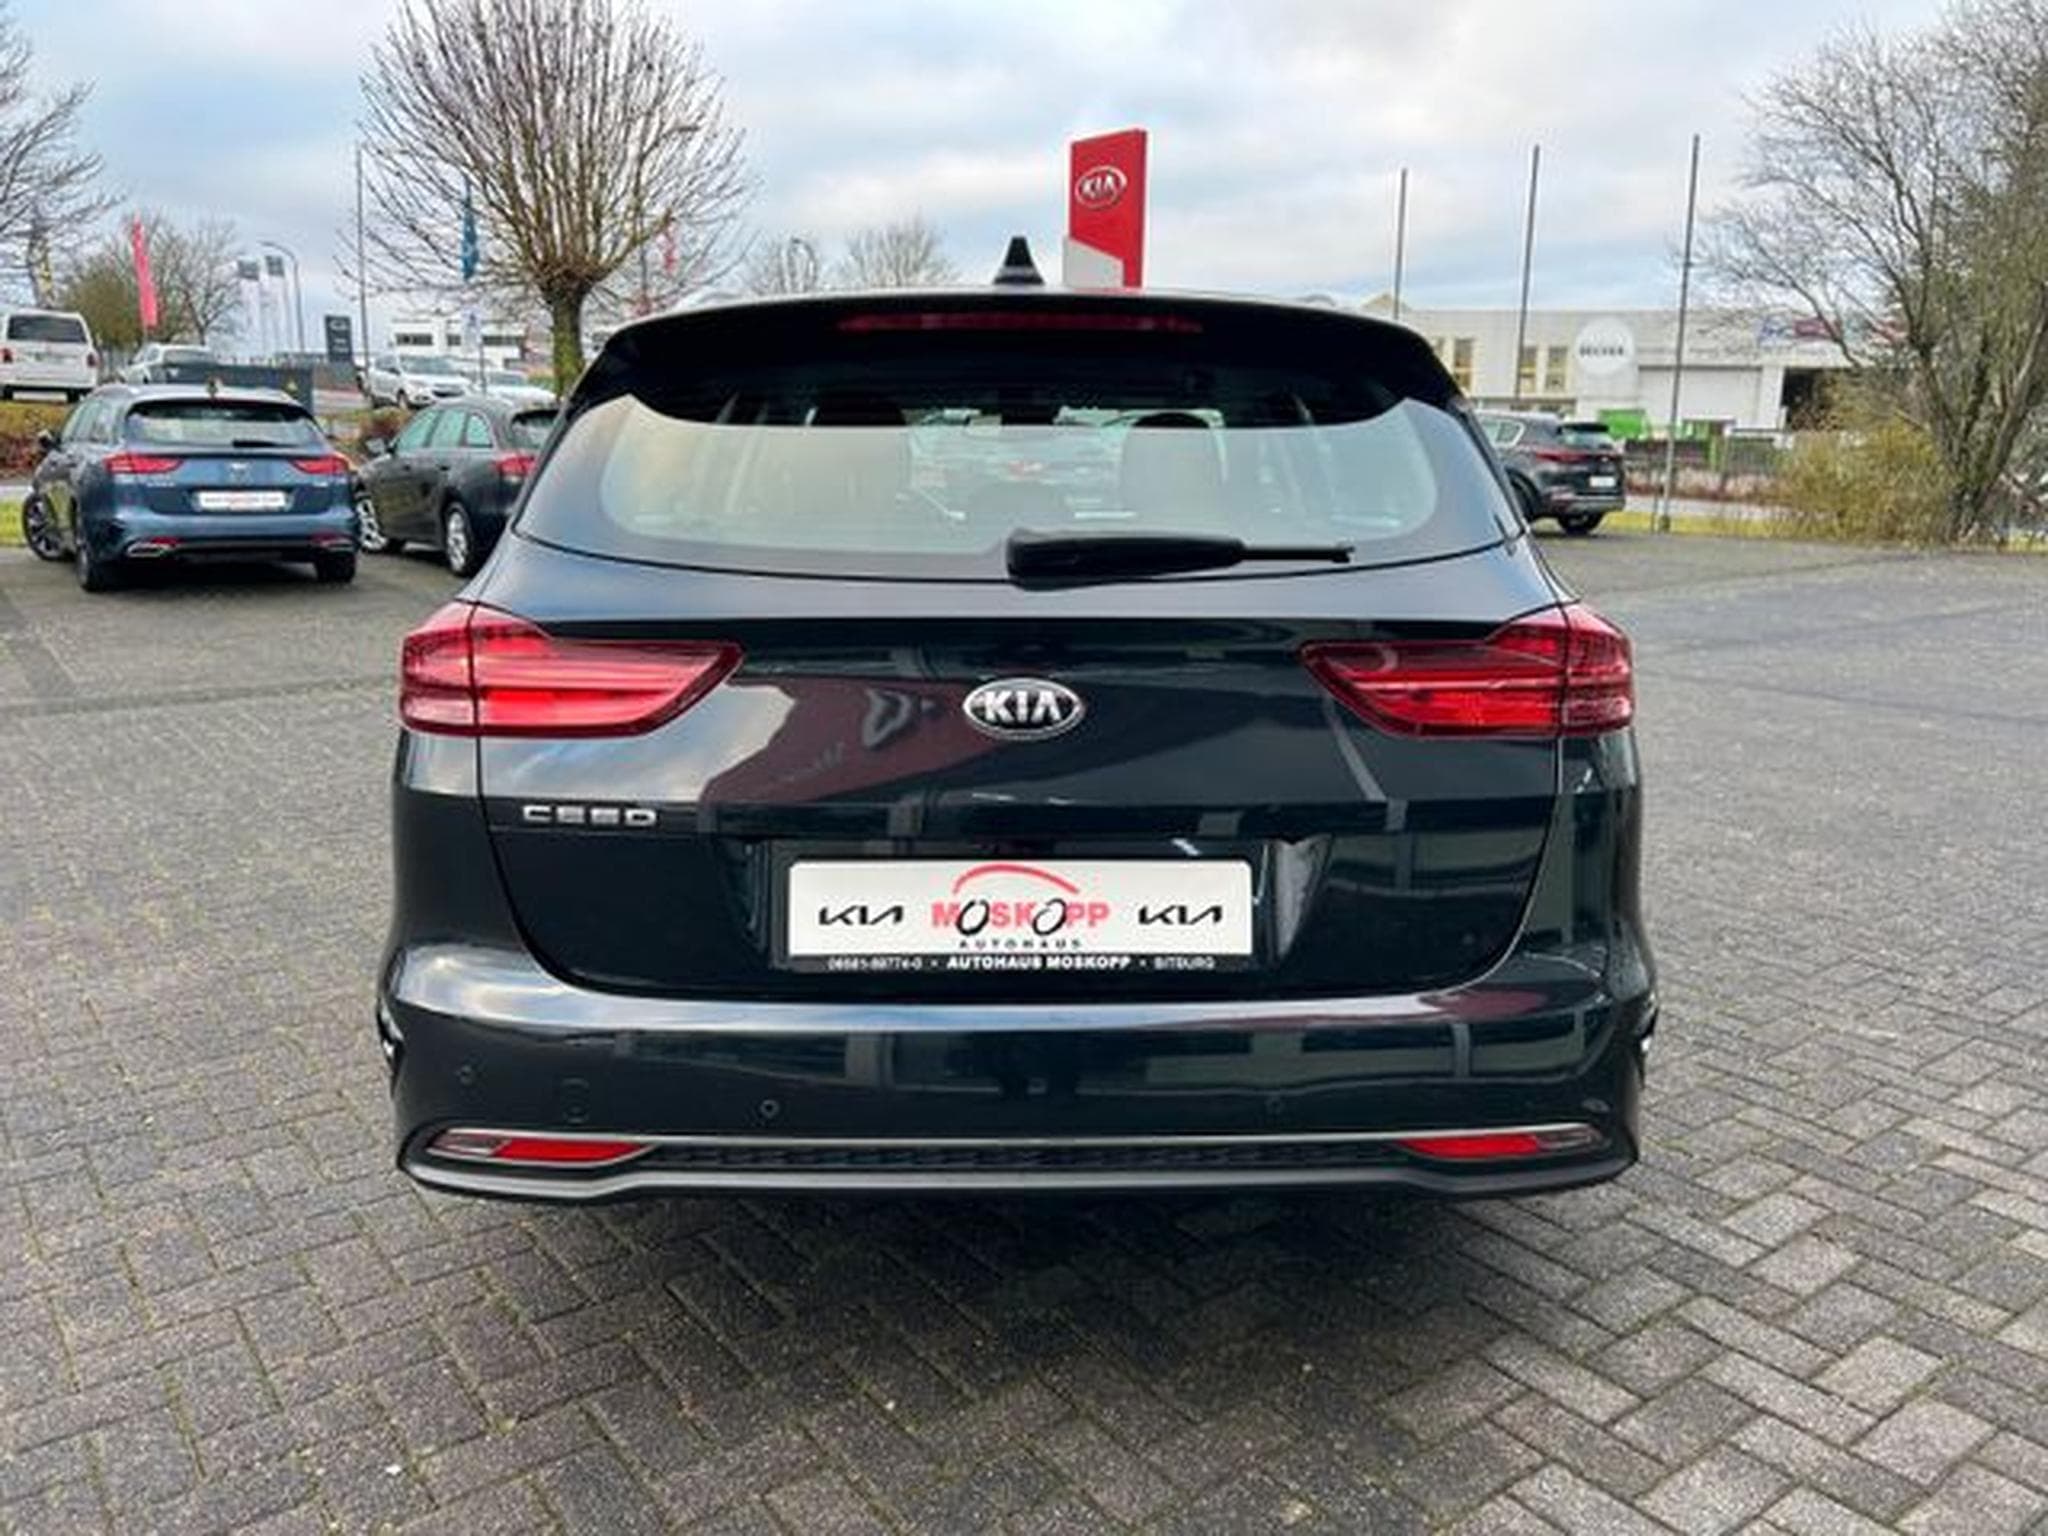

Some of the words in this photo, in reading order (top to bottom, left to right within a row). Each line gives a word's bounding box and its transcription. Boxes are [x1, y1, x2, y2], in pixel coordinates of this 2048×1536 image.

[984, 689, 1061, 722] KIA
[819, 905, 903, 926] KIA
[931, 898, 1110, 936] MOSKOPP
[1138, 905, 1223, 926] KIA
[959, 940, 1081, 949] AUTOHAUS
[946, 956, 1041, 970] AUTOHAUS
[1046, 956, 1131, 970] MOSKOPP
